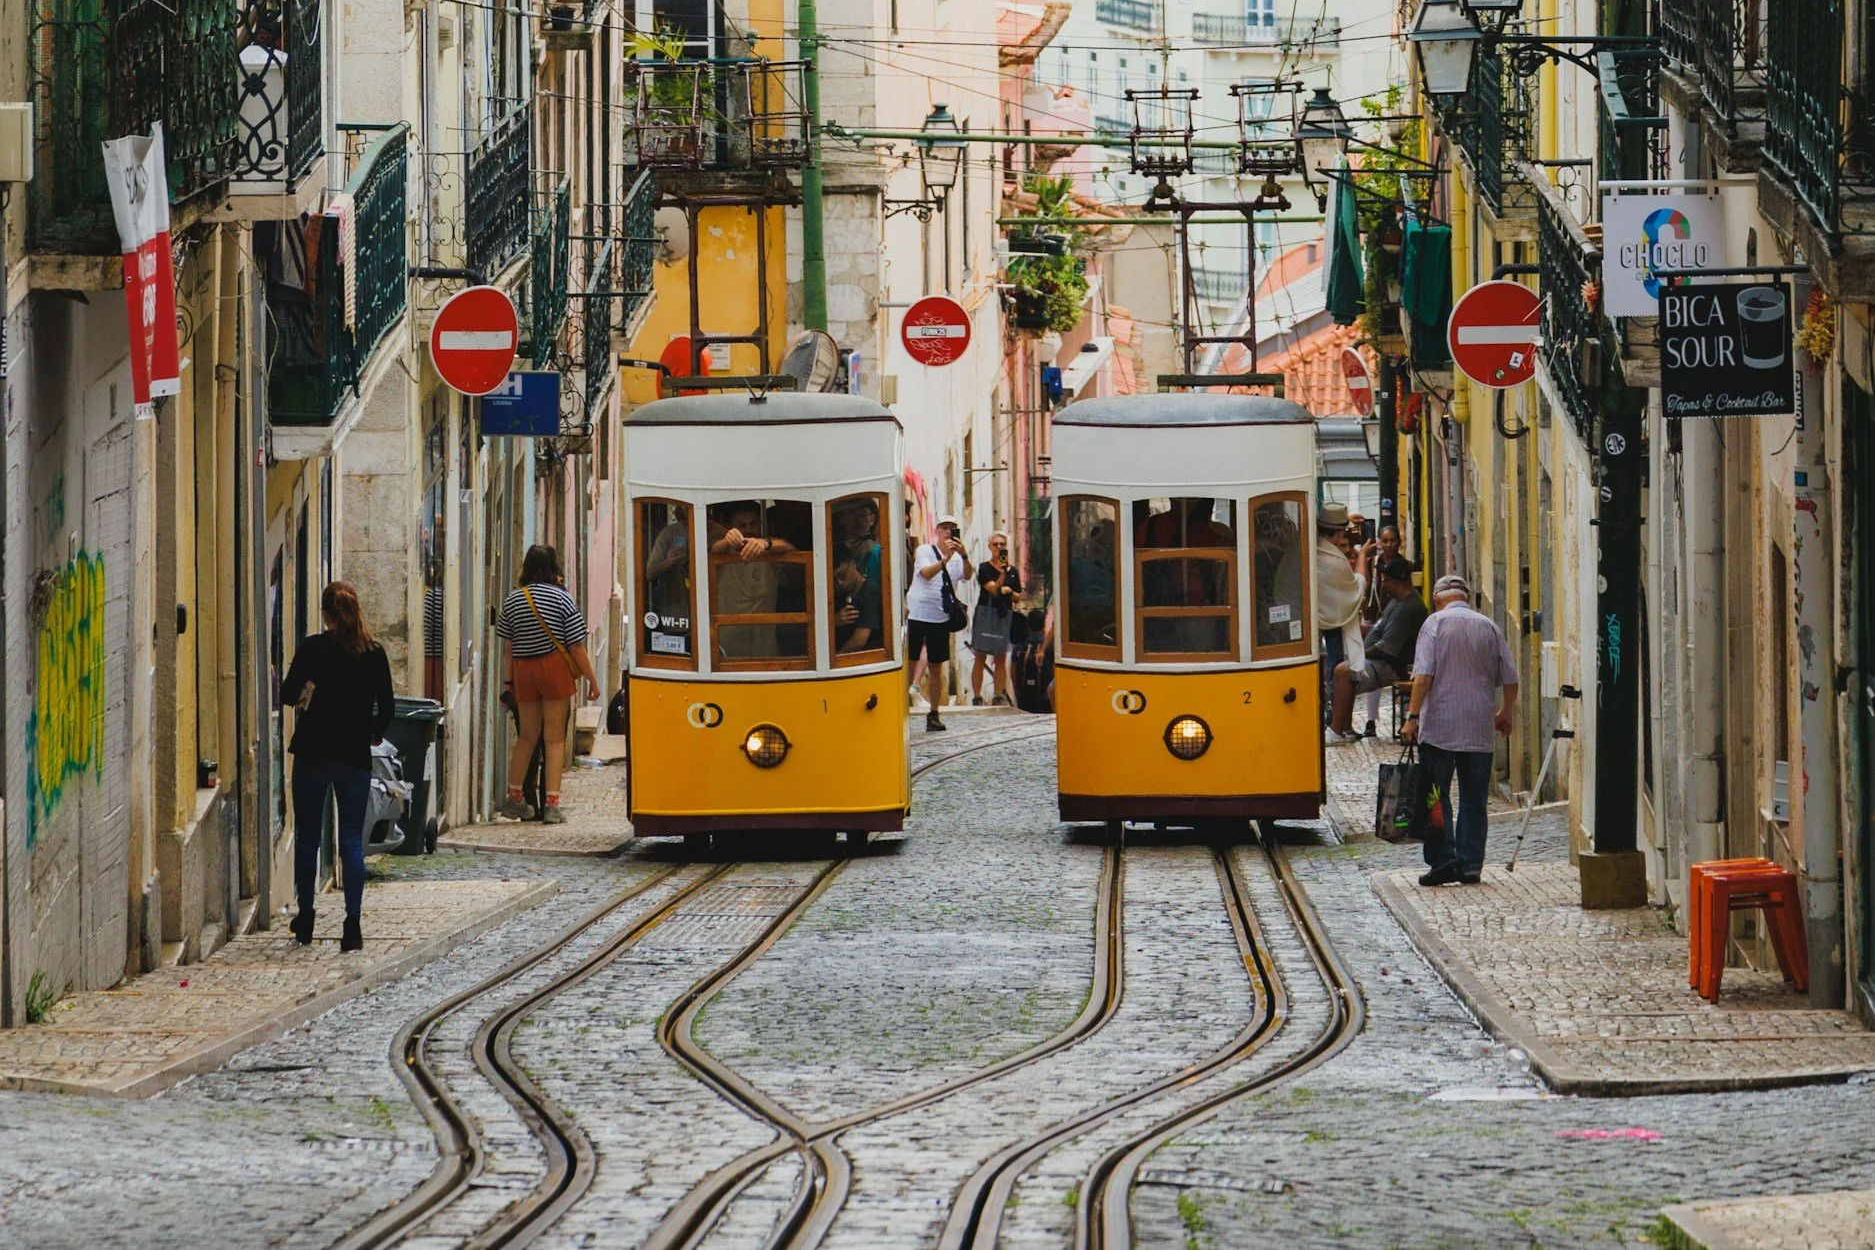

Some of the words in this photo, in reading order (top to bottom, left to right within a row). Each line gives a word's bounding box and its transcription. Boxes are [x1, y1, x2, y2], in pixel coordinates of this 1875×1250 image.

[1620, 242, 1709, 269] CHOCLO
[1665, 295, 1725, 328] BICA
[1666, 335, 1736, 369] SOUR
[1667, 394, 1700, 414] Tapas
[1702, 393, 1714, 412] &
[1716, 393, 1759, 411] Cocktail
[1761, 391, 1786, 408] Bar
[661, 616, 689, 629] WI-FI
[822, 700, 827, 713] 1
[1243, 691, 1252, 704] 2
